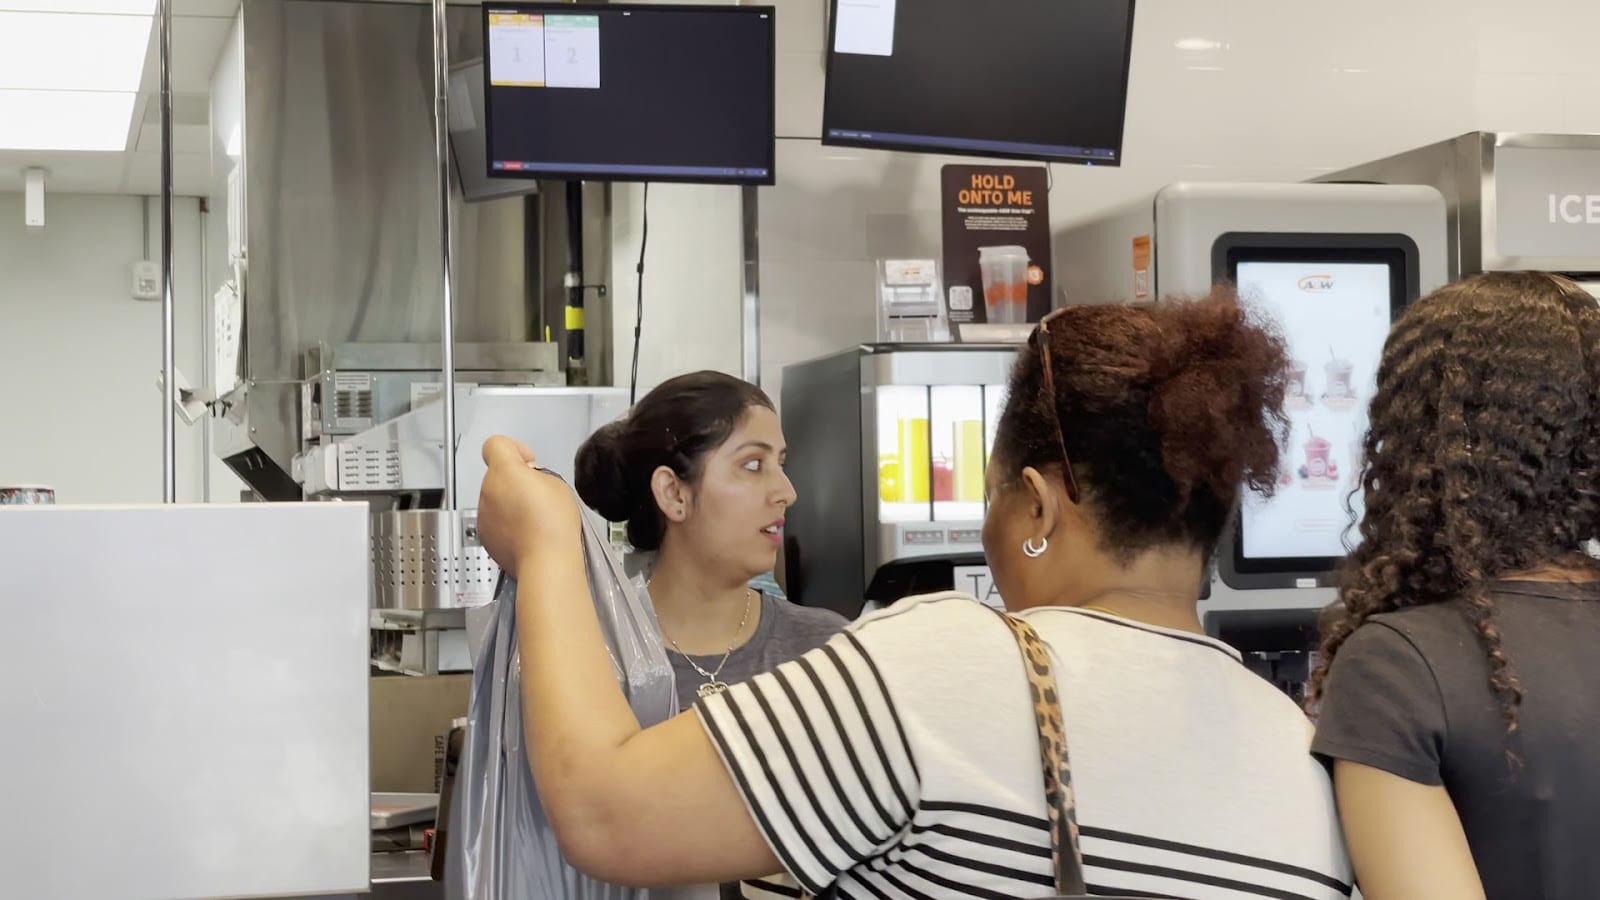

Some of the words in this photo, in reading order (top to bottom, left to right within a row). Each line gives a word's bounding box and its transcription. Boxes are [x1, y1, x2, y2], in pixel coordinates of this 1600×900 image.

[512, 47, 521, 63] 1
[566, 47, 578, 63] 2
[971, 174, 1015, 189] HOLD
[958, 189, 1003, 205] ONTO
[1007, 190, 1033, 206] ME
[1548, 194, 1600, 224] ICE
